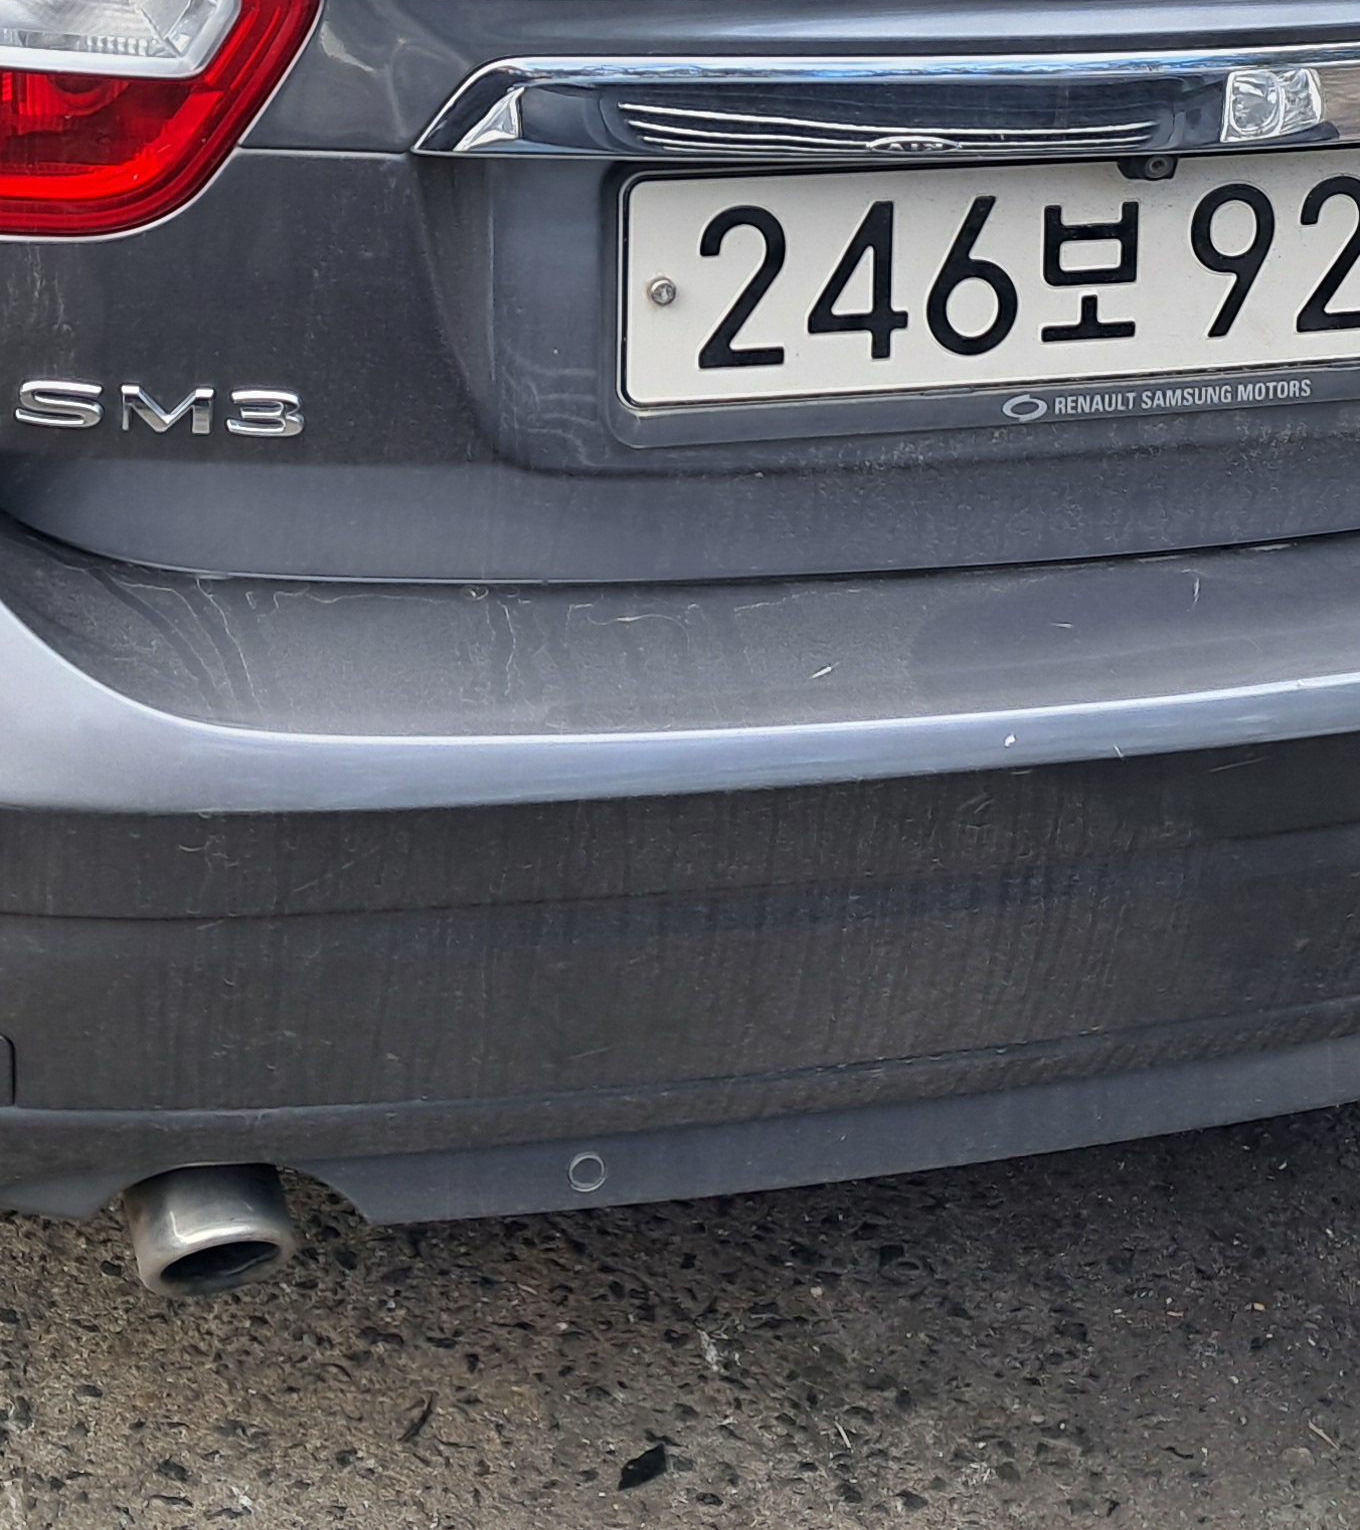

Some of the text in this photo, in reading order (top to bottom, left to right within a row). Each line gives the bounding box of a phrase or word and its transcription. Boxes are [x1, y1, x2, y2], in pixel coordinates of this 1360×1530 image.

[15, 380, 305, 437] SM3
[1053, 378, 1312, 415] RENAULT SAMSUNG MOTORS
